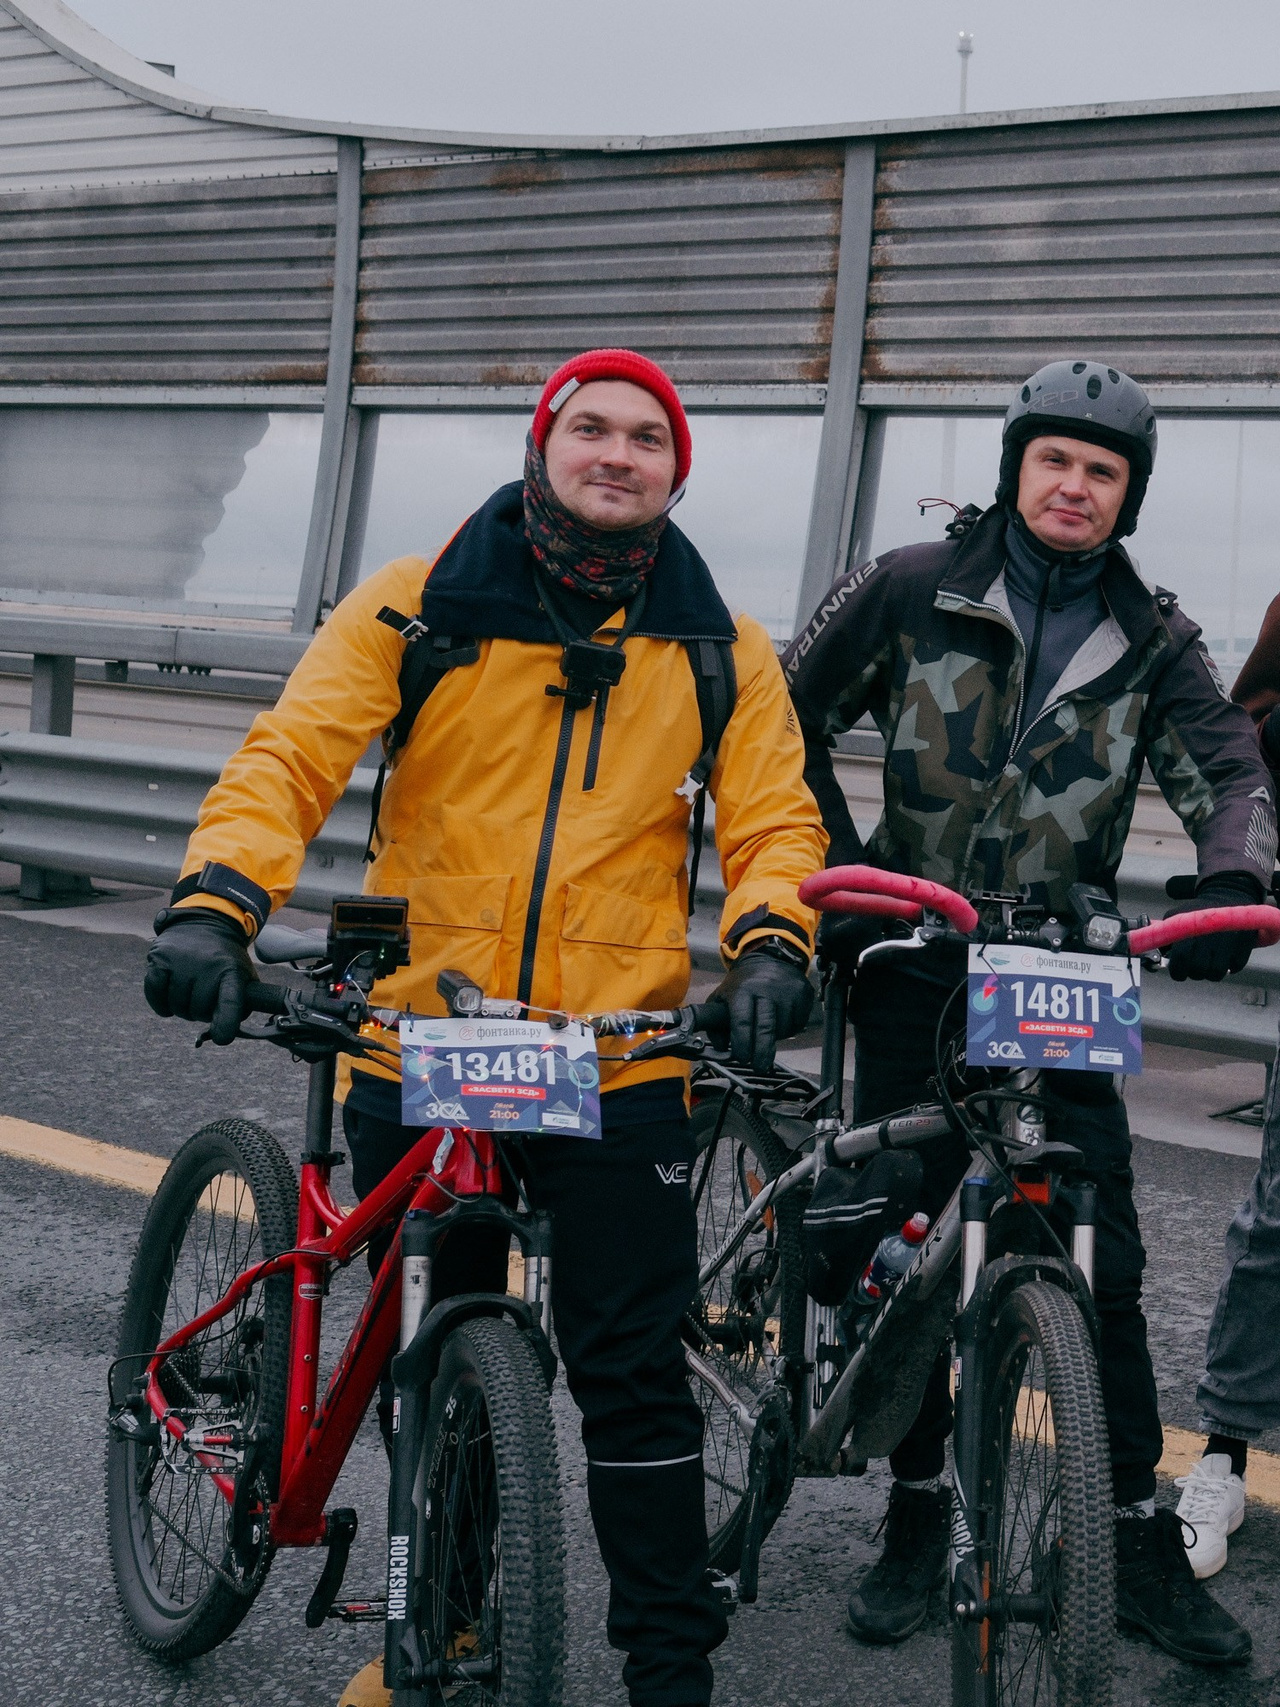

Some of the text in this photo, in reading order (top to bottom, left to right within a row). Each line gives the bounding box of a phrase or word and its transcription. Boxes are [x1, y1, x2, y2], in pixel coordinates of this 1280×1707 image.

[782, 560, 879, 690] FINNTRAI
[1036, 954, 1092, 974] фонтанка.ру
[1010, 981, 1100, 1023] 14811
[476, 1025, 542, 1040] фонтанка.ру
[1025, 1024, 1088, 1035] «ЗАСВЕТИ ЗСД»
[1043, 1048, 1070, 1058] 21:00
[445, 1050, 557, 1085] 13481
[468, 1086, 540, 1097] «ЗАСВЕТИ ЗСД»
[489, 1110, 520, 1120] 21:00
[387, 1535, 409, 1620] ROCKSHOX
